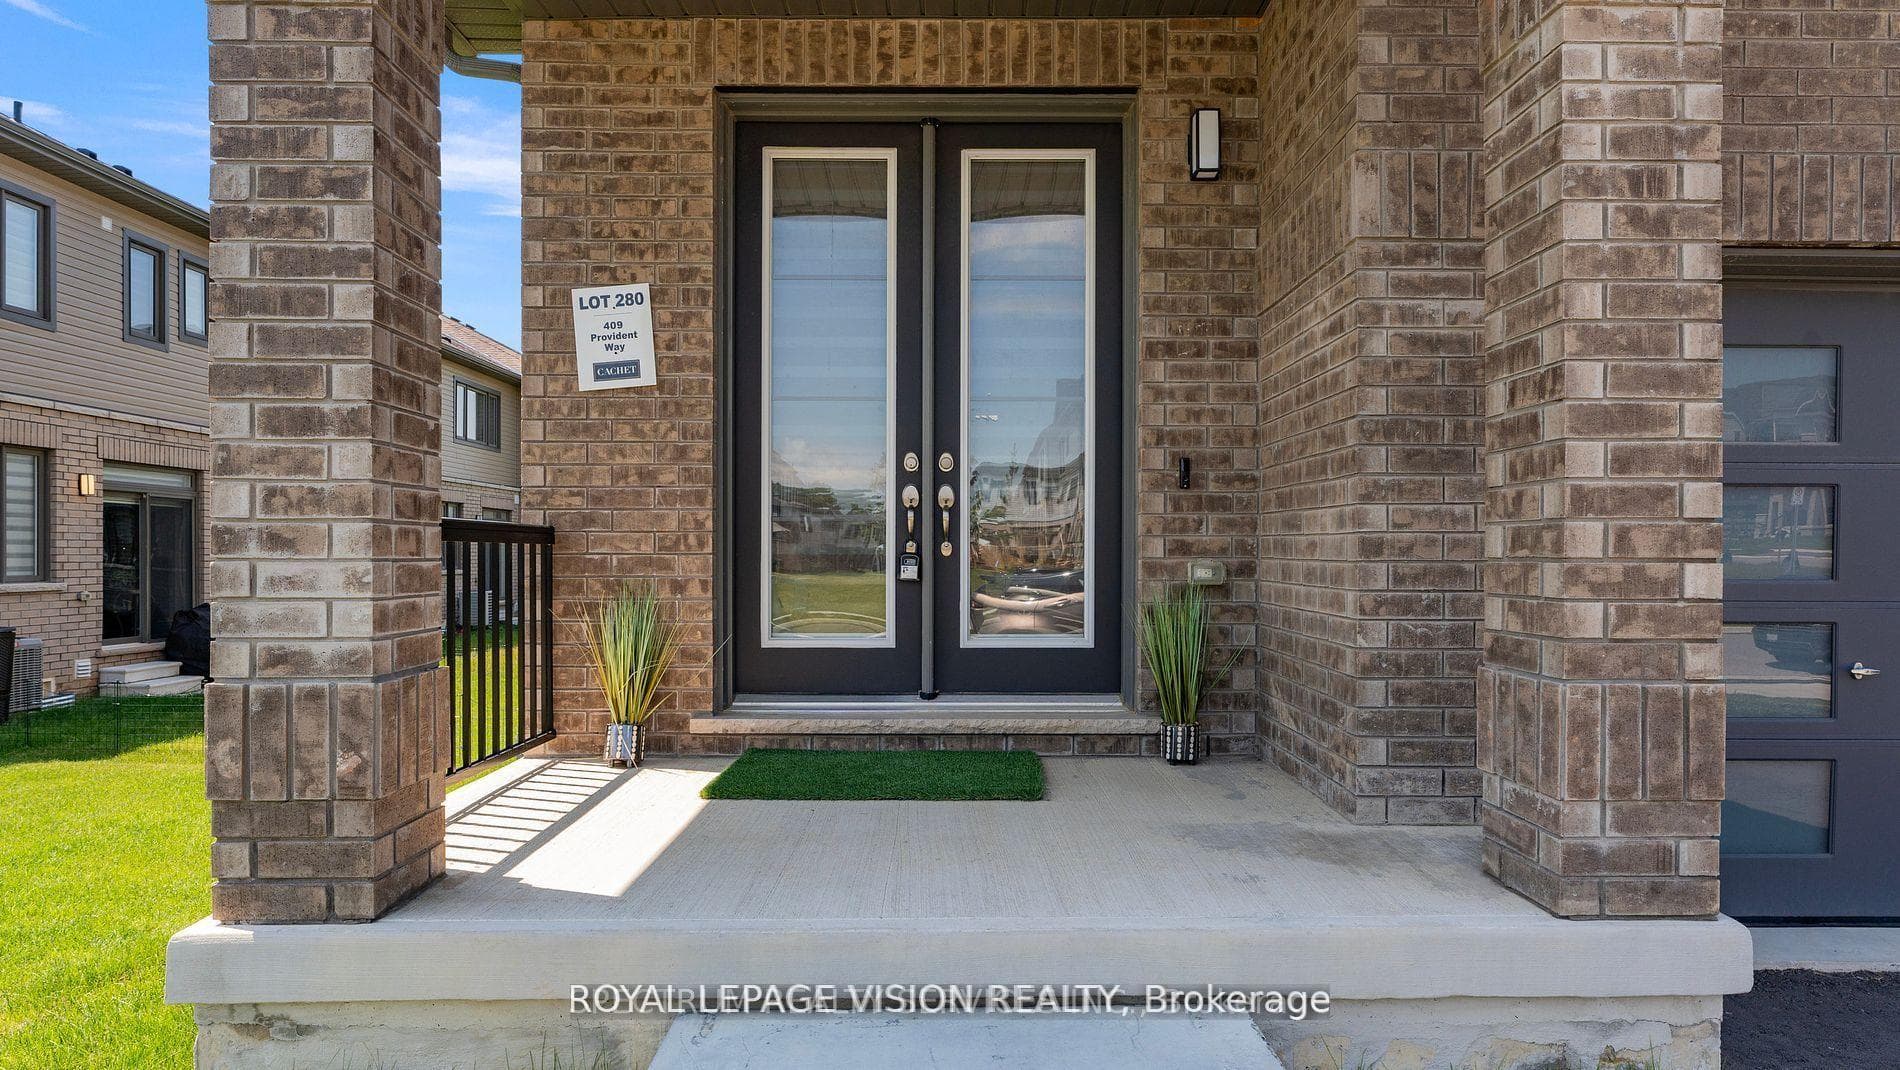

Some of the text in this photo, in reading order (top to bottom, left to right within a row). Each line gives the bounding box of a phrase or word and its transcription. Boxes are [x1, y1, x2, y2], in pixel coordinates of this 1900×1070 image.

[578, 292, 644, 310] LOT 280
[603, 320, 623, 330] 409
[590, 331, 638, 342] Provident
[604, 343, 625, 352] Way
[597, 365, 637, 376] CACHET
